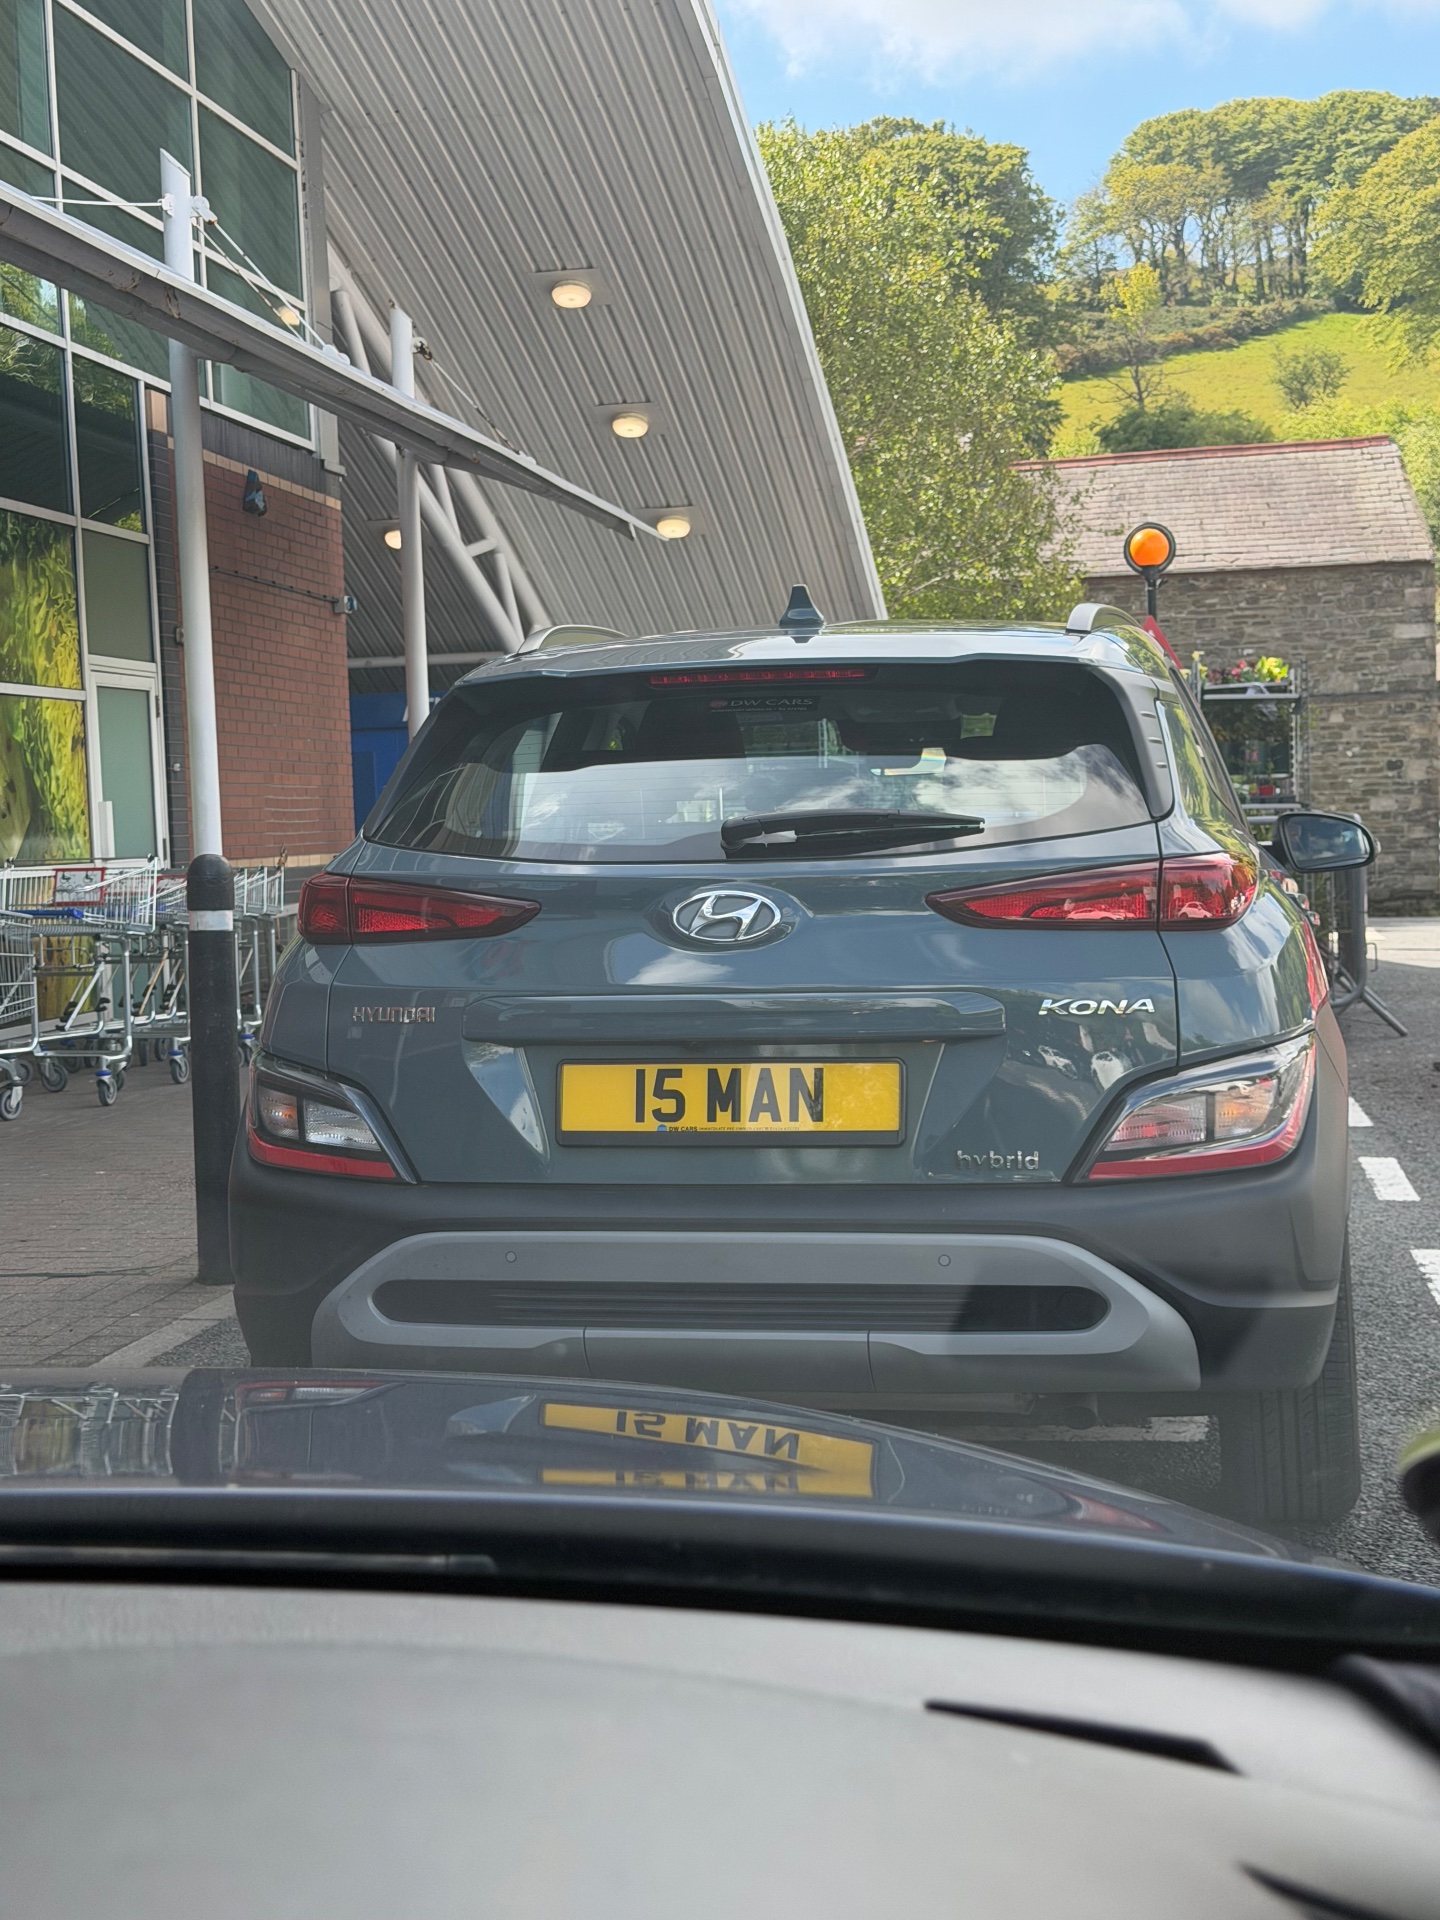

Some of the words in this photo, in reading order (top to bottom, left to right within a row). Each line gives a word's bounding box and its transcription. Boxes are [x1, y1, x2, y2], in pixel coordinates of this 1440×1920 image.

[730, 699, 762, 707] DW
[765, 698, 813, 706] CARS
[352, 1006, 436, 1022] HYUNDAI
[1038, 998, 1155, 1015] KONA
[635, 1068, 686, 1123] 15
[706, 1067, 824, 1123] MAN
[957, 1149, 1039, 1173] hybrid
